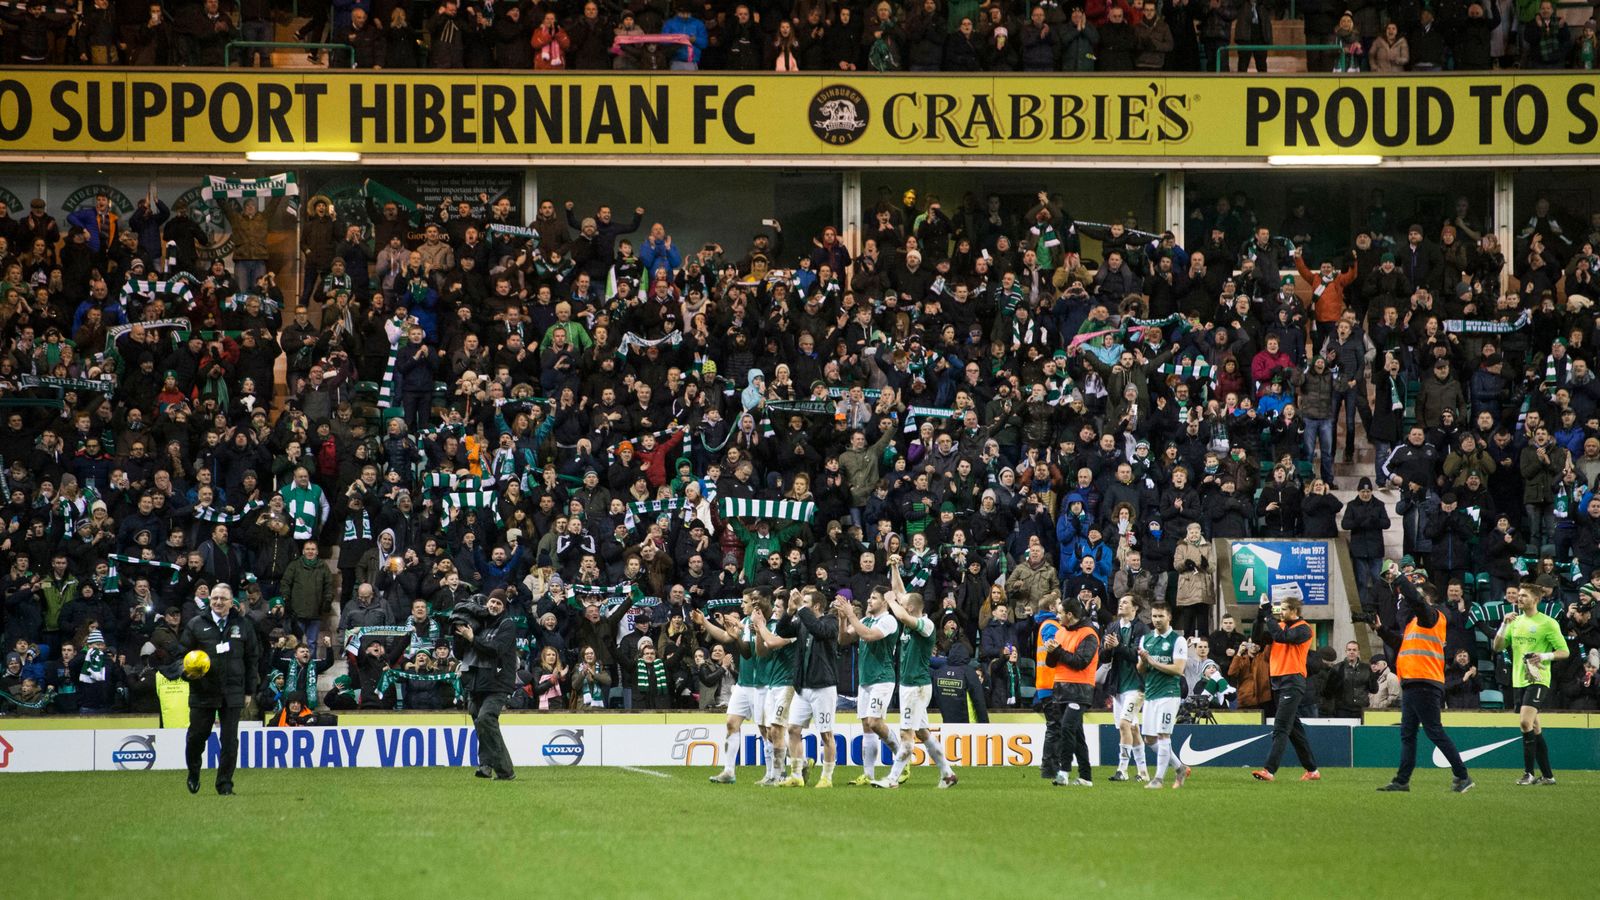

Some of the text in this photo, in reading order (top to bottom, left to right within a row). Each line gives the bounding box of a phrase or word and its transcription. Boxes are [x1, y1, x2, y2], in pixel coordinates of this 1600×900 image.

[50, 80, 327, 143] SUPPORT
[350, 84, 669, 144] HIBERNIAN
[693, 85, 755, 145] FC
[883, 83, 1190, 147] CRABBIE'S
[1246, 83, 1598, 146] PROUD TO S
[1239, 568, 1256, 596] 4
[870, 697, 883, 710] 24
[1126, 702, 1135, 713] 3
[775, 705, 784, 717] 8
[904, 707, 911, 719] 2
[818, 712, 831, 724] 30
[1161, 712, 1172, 724] 19
[115, 752, 154, 760] VOLVO
